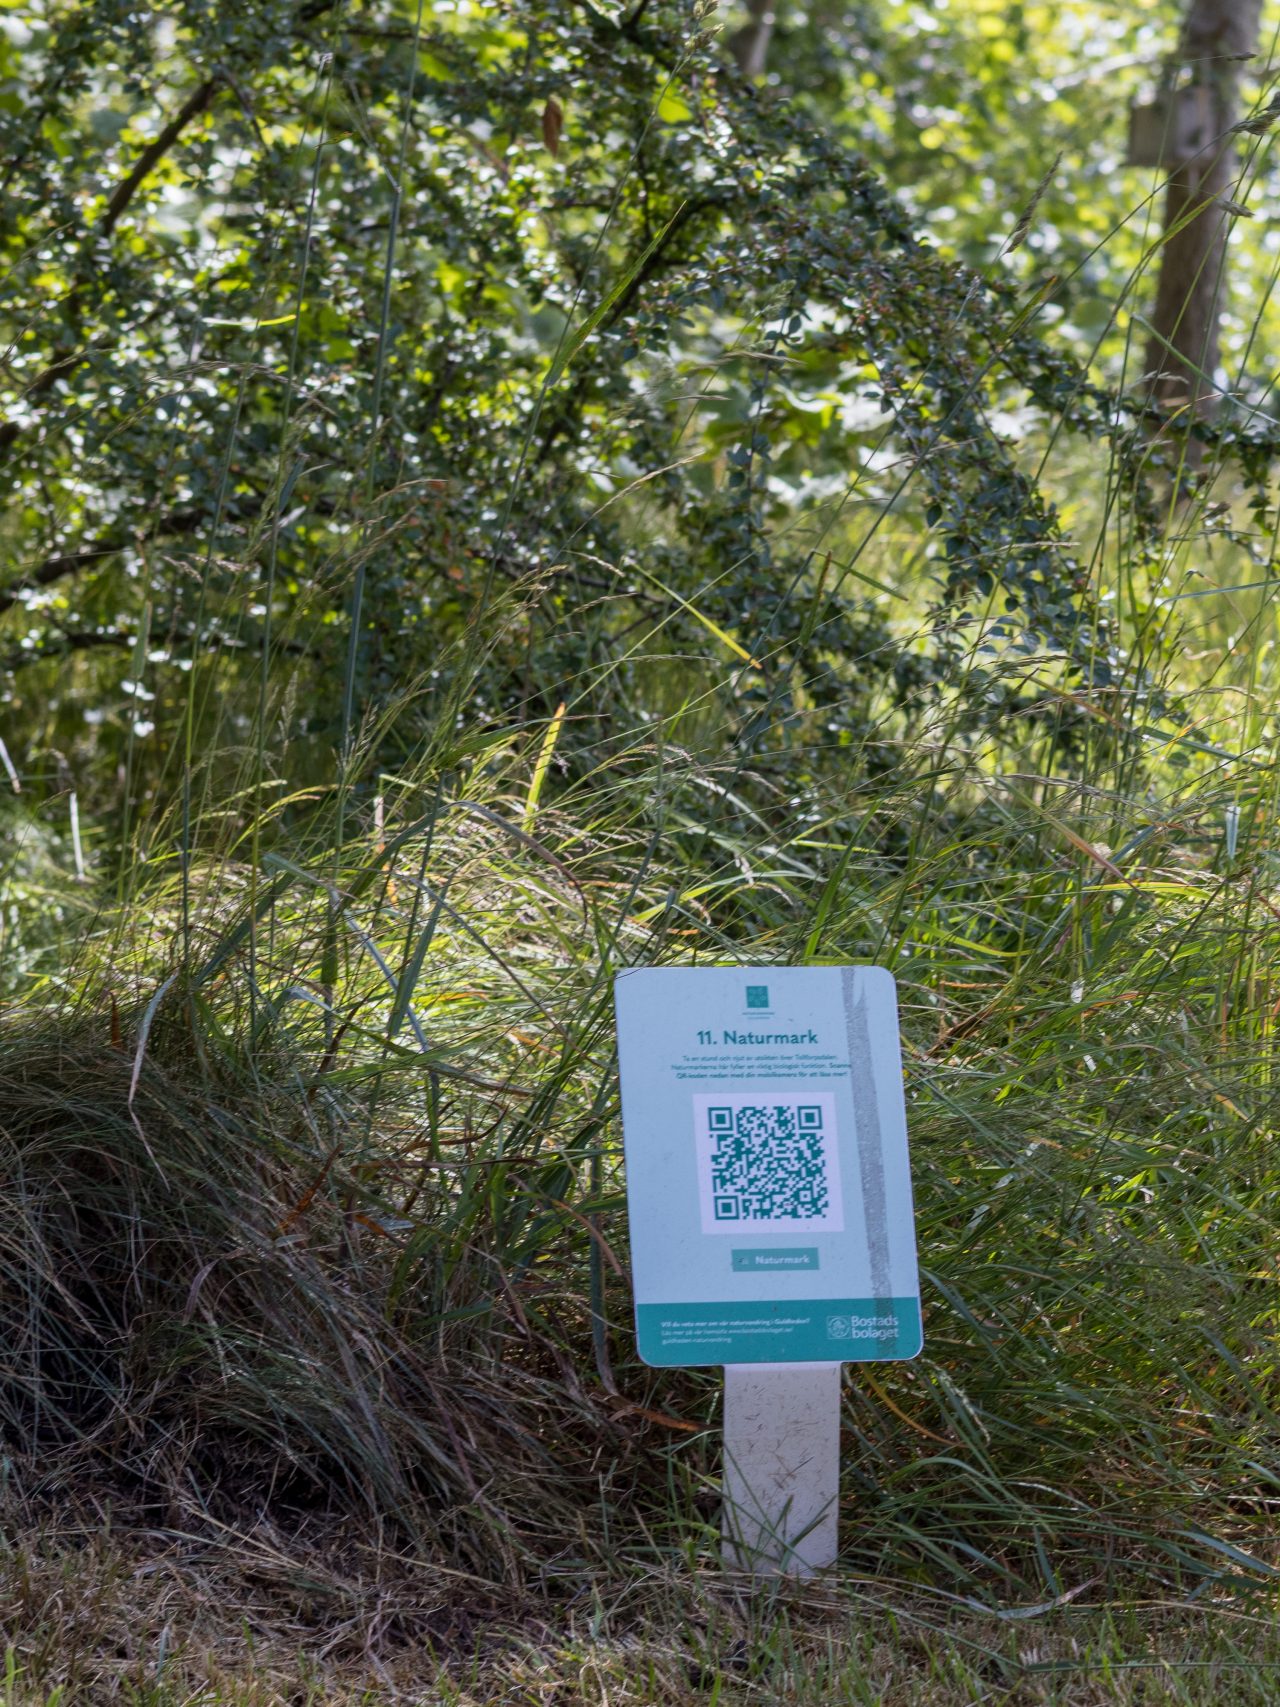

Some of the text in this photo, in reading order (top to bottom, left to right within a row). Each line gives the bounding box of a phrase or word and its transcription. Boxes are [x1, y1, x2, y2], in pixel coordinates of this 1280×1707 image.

[697, 1029, 818, 1045] 11. Naturmark
[755, 1254, 810, 1264] Naturmark
[851, 1315, 899, 1327] Bostads
[851, 1327, 899, 1340] bolaget
